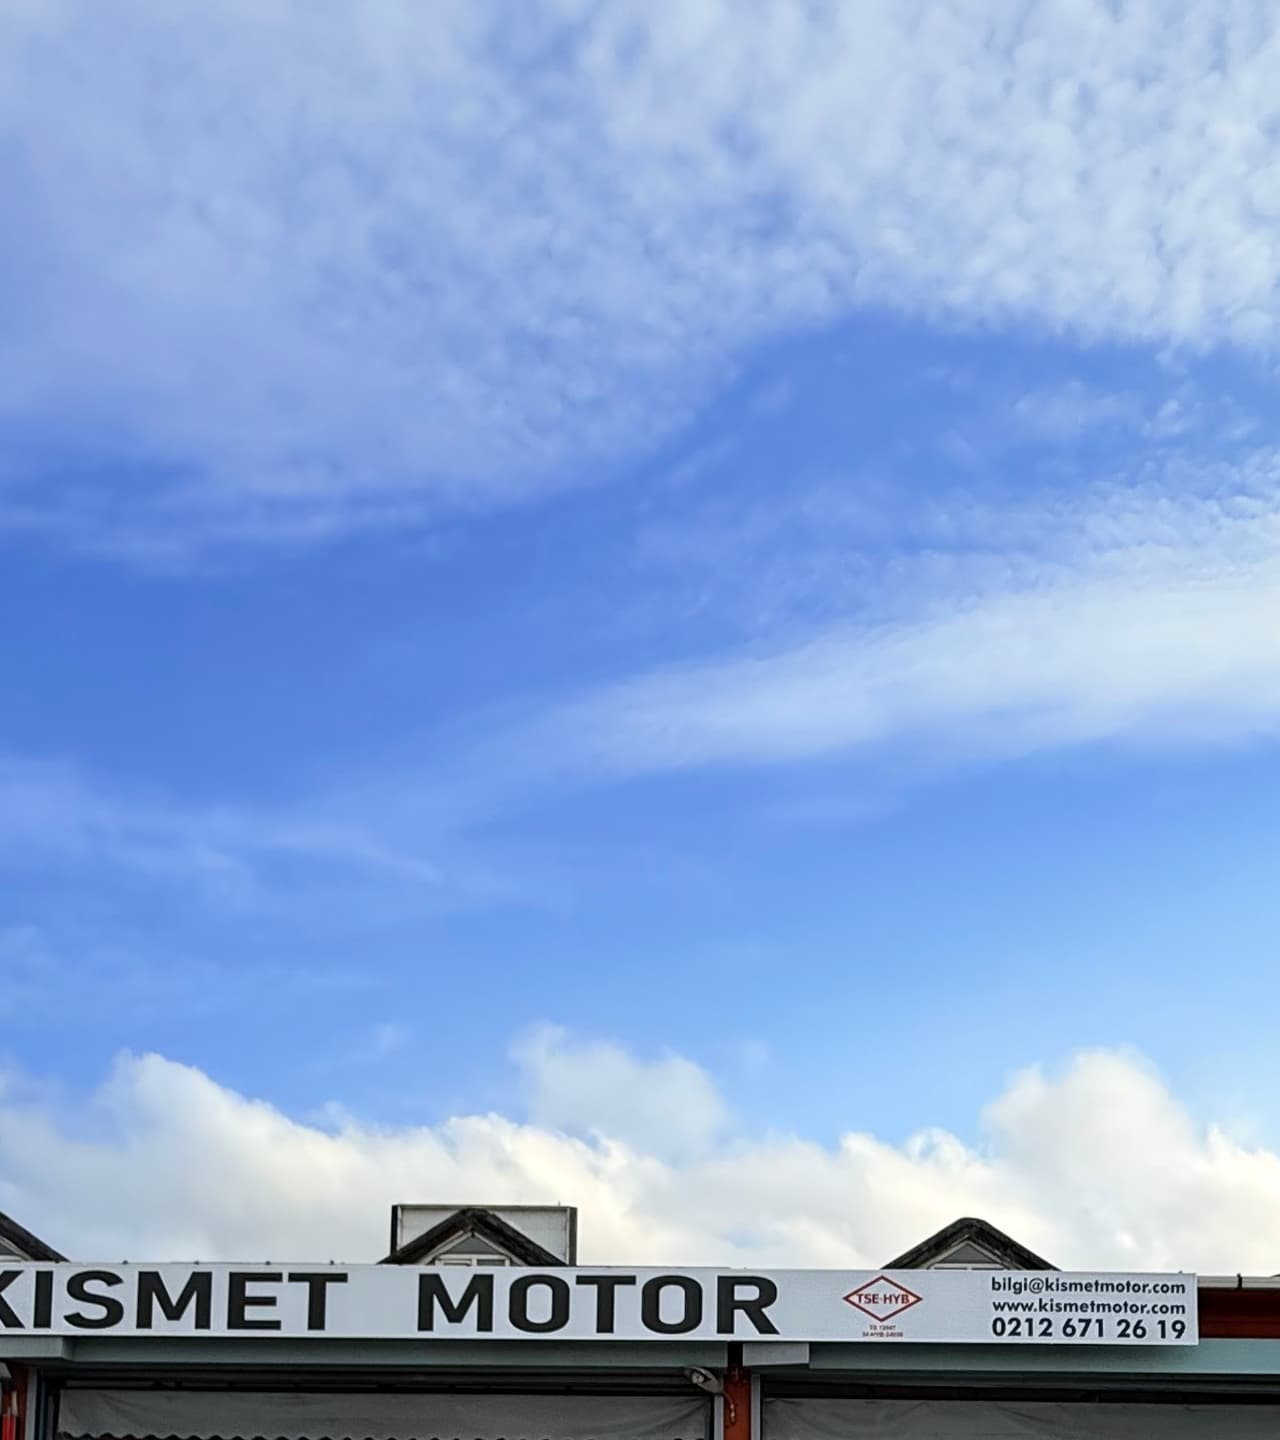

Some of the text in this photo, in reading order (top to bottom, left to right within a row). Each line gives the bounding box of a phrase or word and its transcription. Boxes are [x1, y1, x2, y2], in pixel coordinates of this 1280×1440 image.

[991, 1276, 1186, 1295] bilgi@kismetmotor.com
[418, 1273, 780, 1335] MOTOR
[992, 1298, 1186, 1315] www.kismetmotor.com
[992, 1317, 1186, 1339] 0212 671 26 19
